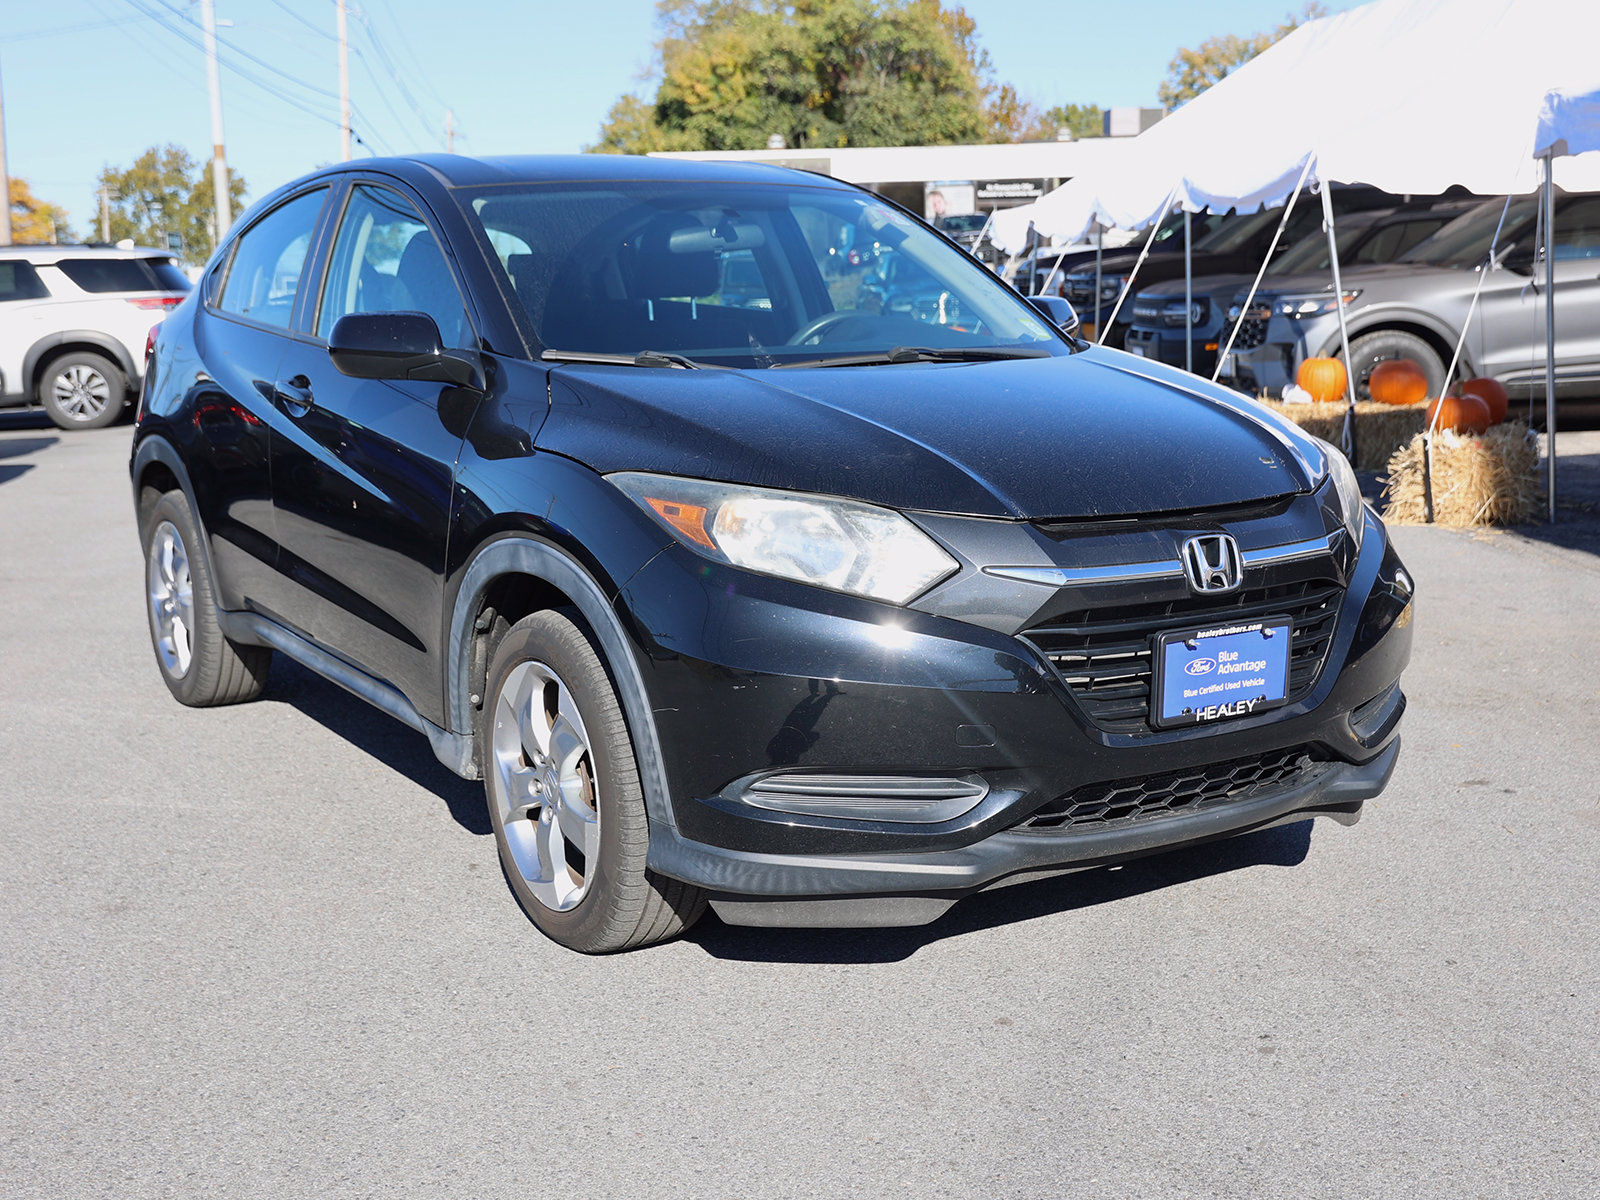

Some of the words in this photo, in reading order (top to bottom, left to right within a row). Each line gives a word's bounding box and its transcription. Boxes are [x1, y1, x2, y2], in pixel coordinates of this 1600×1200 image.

[1218, 650, 1239, 663] Blue
[1190, 660, 1210, 673] Ford
[1217, 660, 1267, 675] Advantage
[1183, 689, 1198, 698] Blue
[1198, 683, 1224, 695] Certified
[1224, 680, 1241, 690] Used
[1242, 678, 1266, 688] Vehicle
[1196, 698, 1257, 722] HEALEY
